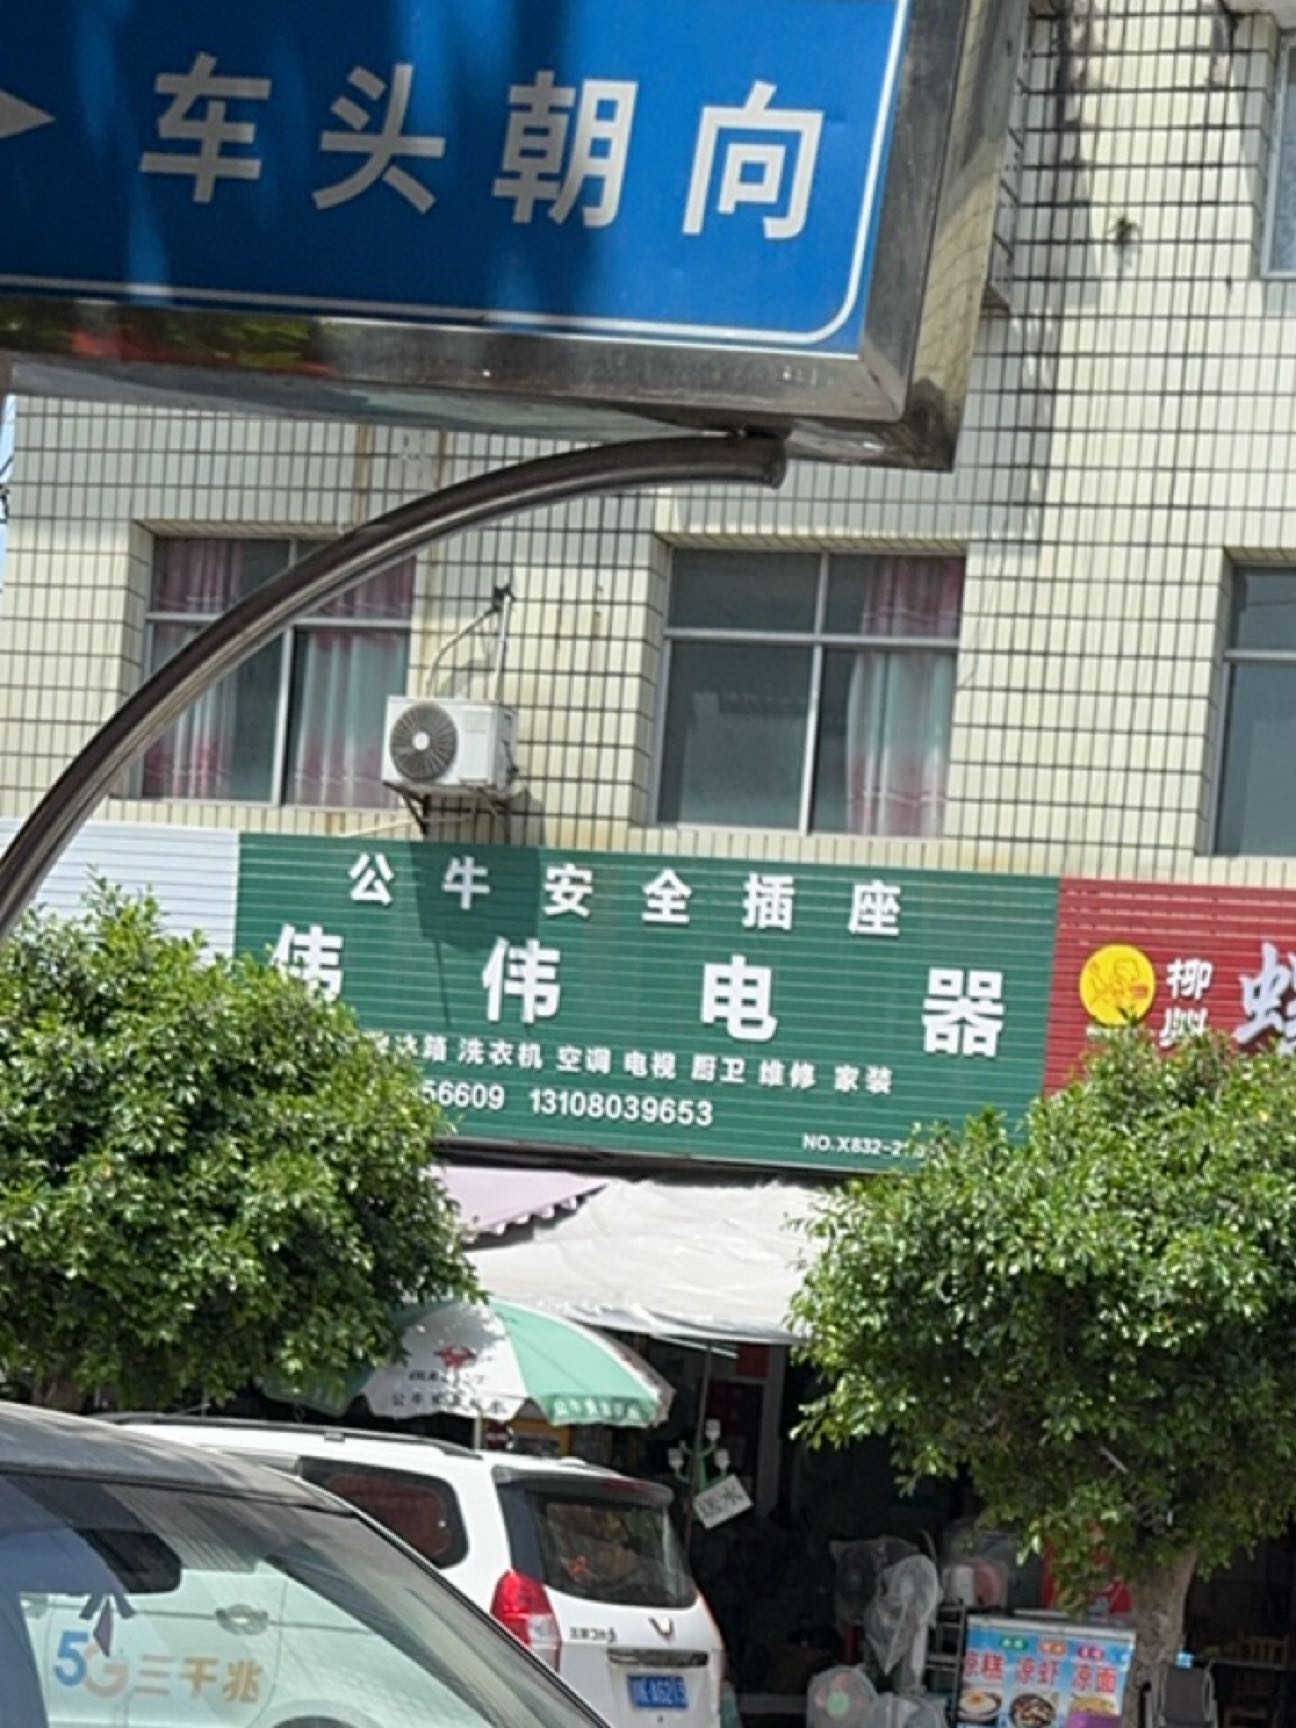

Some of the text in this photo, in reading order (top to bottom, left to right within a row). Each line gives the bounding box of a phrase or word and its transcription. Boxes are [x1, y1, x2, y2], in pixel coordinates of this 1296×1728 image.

[139, 52, 825, 241] 车头朝向
[349, 852, 902, 938] 公牛安全插座
[268, 923, 1005, 1058] 伟伟电器
[459, 1036, 543, 1069] 洗衣机
[556, 1045, 612, 1075] 空调
[623, 1050, 677, 1080] 电视
[690, 1055, 746, 1084] 厨卫
[758, 1059, 817, 1090] 维修
[834, 1065, 893, 1095] 家装
[530, 1087, 714, 1127] 13108039653
